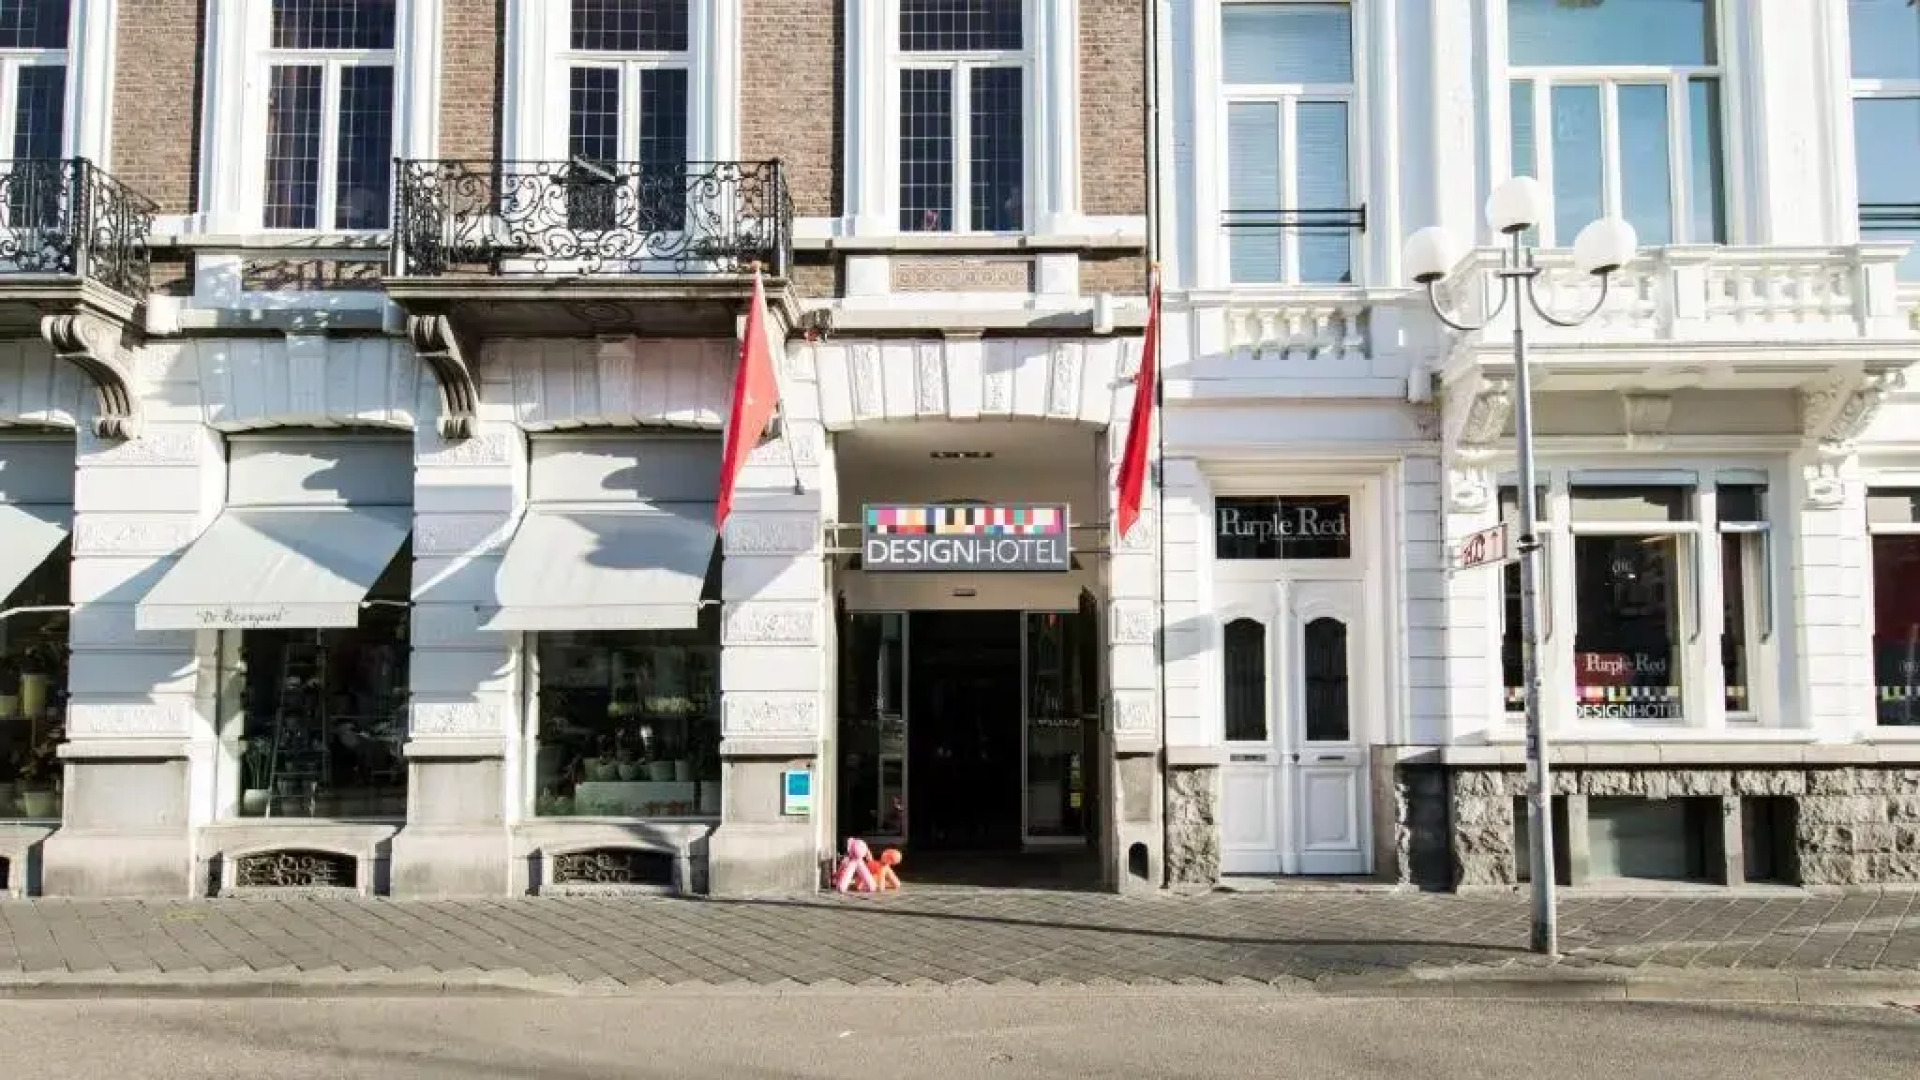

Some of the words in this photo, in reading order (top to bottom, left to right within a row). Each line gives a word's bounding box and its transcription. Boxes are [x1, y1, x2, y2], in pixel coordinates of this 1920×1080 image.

[1217, 507, 1293, 543] Purple
[1296, 507, 1347, 535] Red
[867, 539, 1064, 563] DESIGNHOTEL
